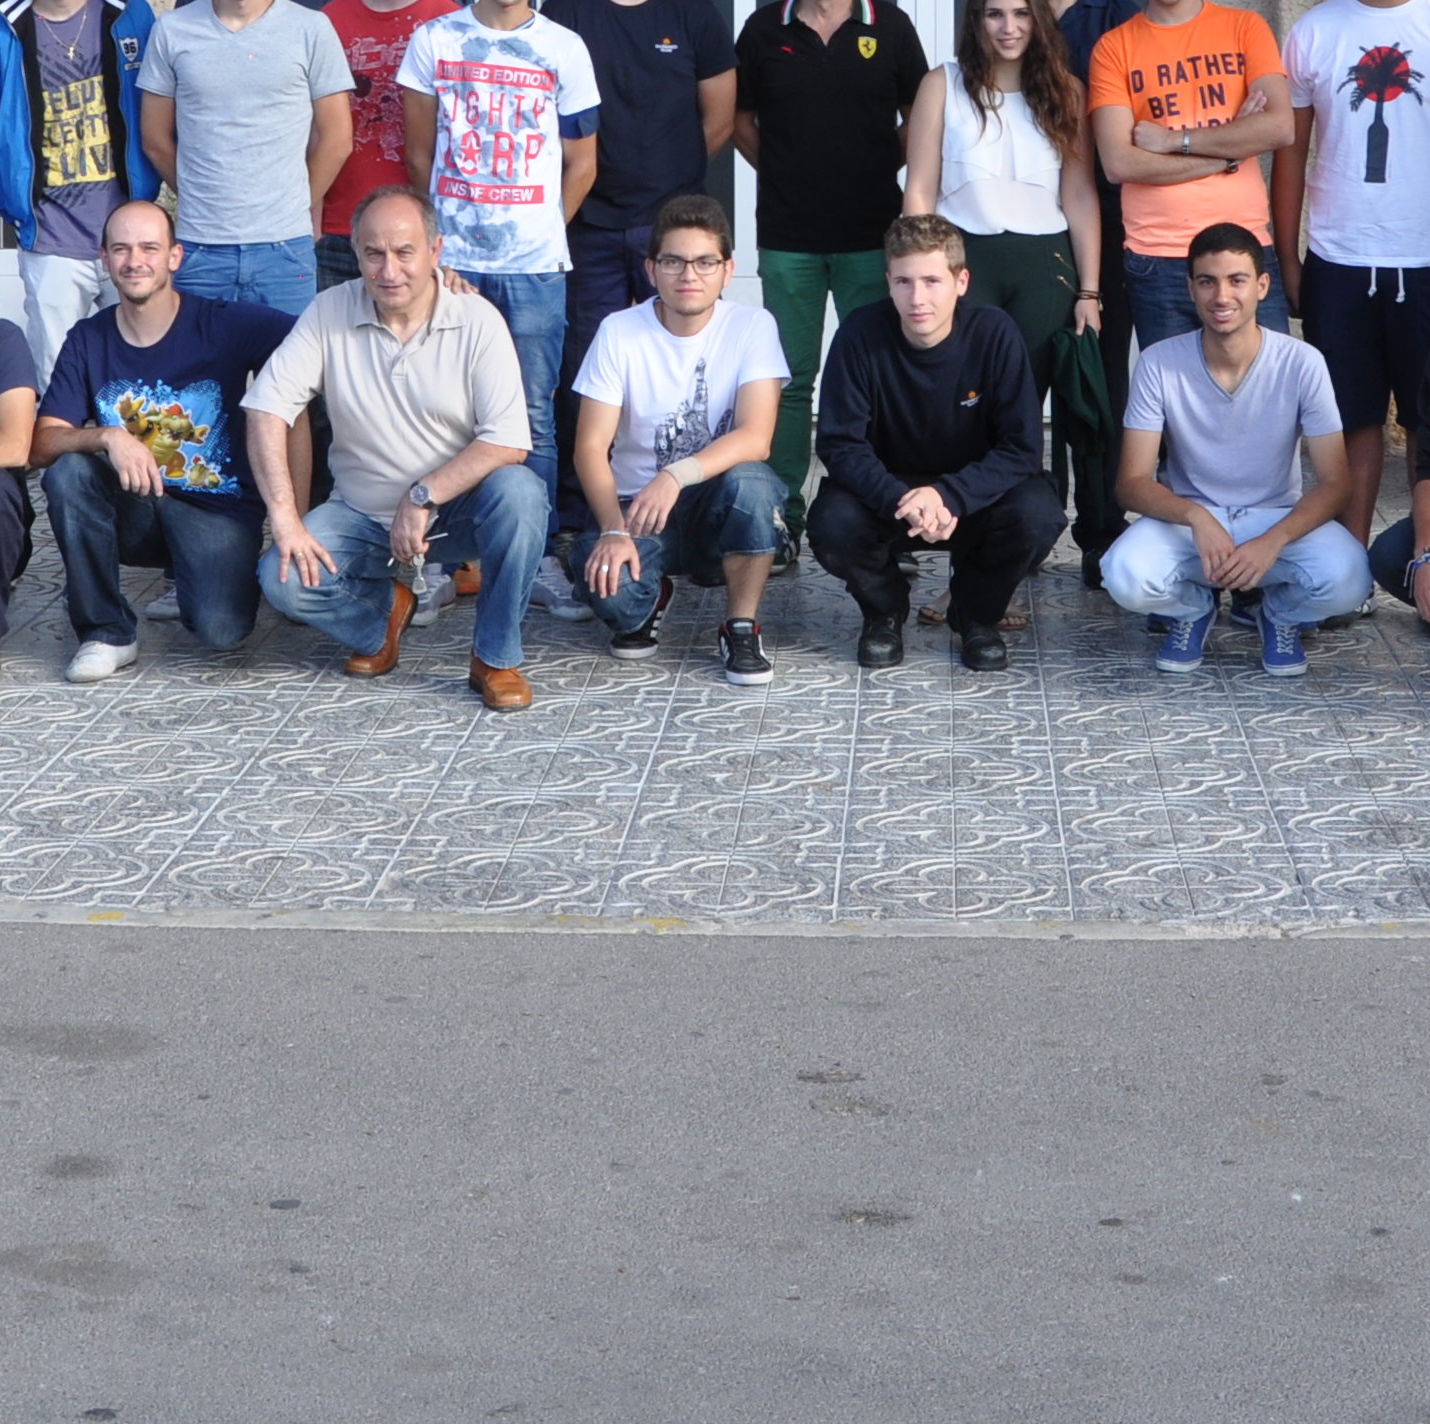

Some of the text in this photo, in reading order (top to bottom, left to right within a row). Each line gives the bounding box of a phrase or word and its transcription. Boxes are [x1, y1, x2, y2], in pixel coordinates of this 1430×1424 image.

[440, 64, 551, 87] LIMITED EDITION
[1156, 52, 1246, 87] RATHER
[1147, 82, 1226, 119] BE IN
[445, 181, 535, 202] INSDE CREW
